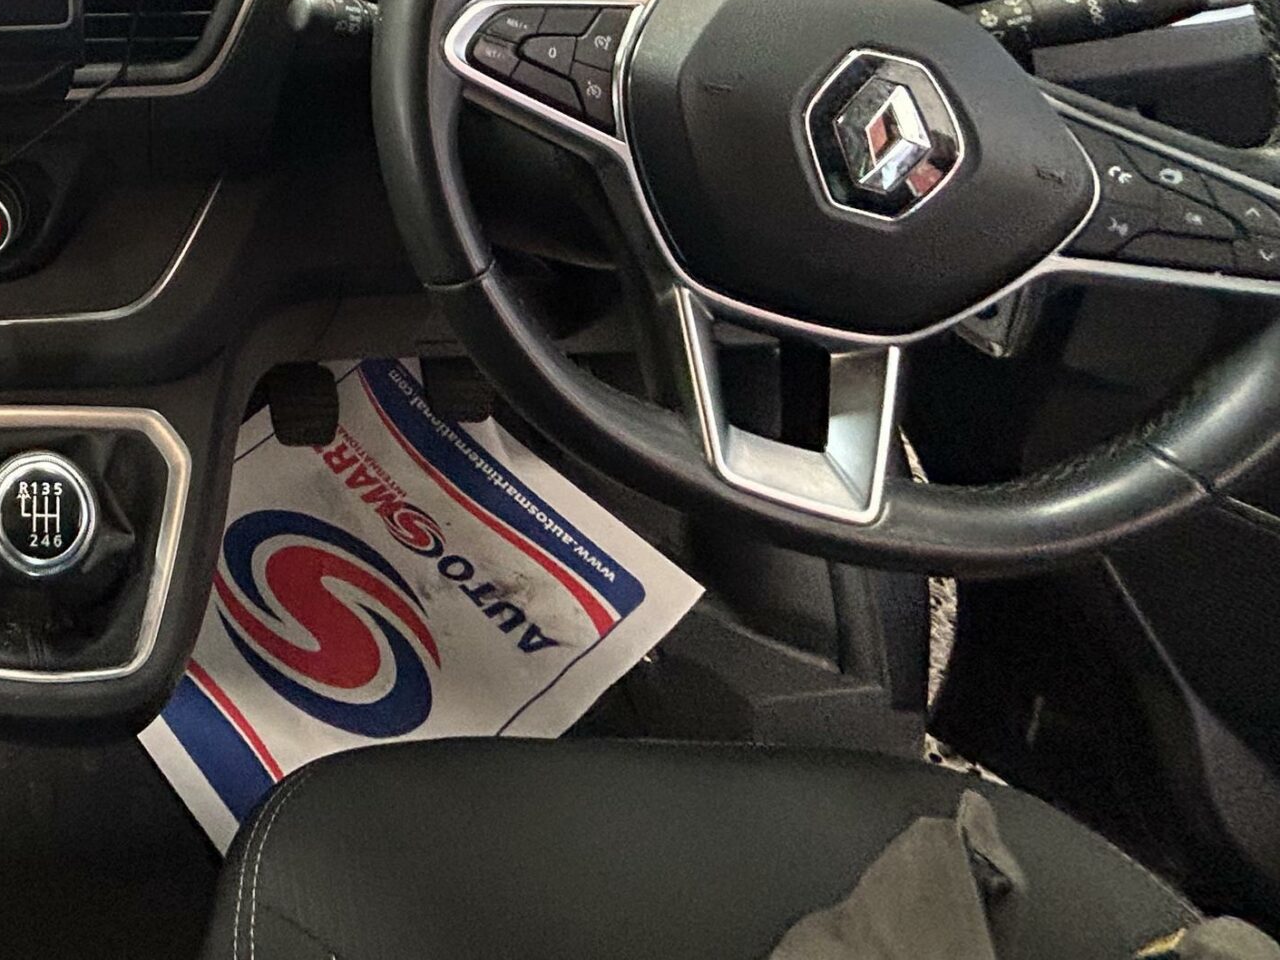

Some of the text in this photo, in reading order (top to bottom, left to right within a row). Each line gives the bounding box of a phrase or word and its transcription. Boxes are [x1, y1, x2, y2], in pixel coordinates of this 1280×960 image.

[337, 423, 407, 498] INTERNATIONA
[19, 481, 63, 496] R 1 3 5
[29, 534, 62, 548] 2 4 6
[312, 442, 561, 653] AUTOSMAR
